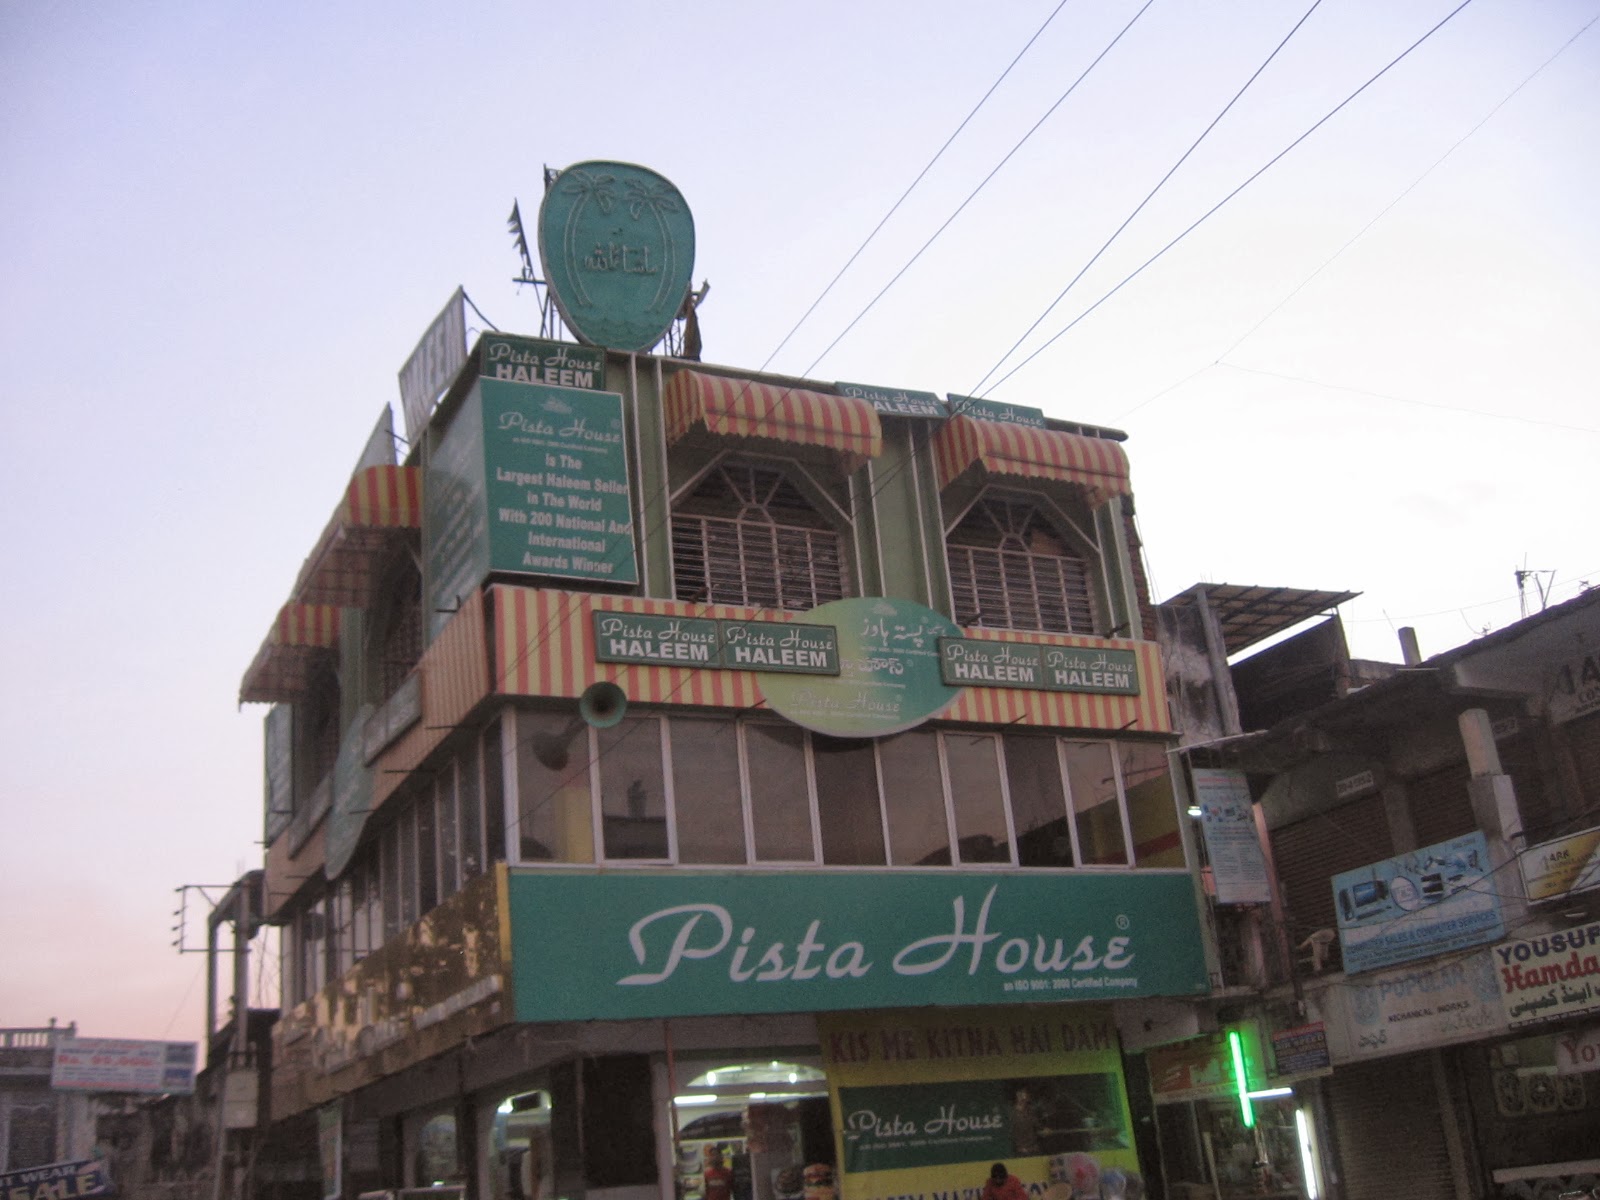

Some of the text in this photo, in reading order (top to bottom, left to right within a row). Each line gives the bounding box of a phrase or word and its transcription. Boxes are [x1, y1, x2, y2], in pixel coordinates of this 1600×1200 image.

[488, 342, 602, 371] Pista House
[496, 363, 593, 388] HALEEM
[844, 386, 940, 408] Pista House
[874, 400, 940, 416] ALEEM
[956, 399, 995, 419] Pista
[998, 407, 1045, 427] House
[498, 411, 621, 444] Pista House
[560, 455, 582, 471] The
[497, 467, 629, 496] Largest Haleem Seller
[542, 492, 566, 508] The
[568, 494, 602, 512] World
[499, 508, 633, 535] With 200 National And
[528, 532, 605, 553] International
[522, 552, 614, 574] Awards Winner
[601, 618, 716, 645] Pista House
[727, 627, 834, 651] Pista House
[610, 639, 710, 662] HALEEM
[736, 647, 828, 668] HALEEM
[947, 644, 989, 663] Pista
[993, 646, 1040, 667] House
[1047, 651, 1134, 673] Pista House
[954, 663, 1035, 684] HALEEM
[1055, 669, 1131, 689] HALEEM
[847, 691, 901, 713] House
[615, 883, 1135, 986] Pista House
[847, 1104, 1004, 1141] Pista House
